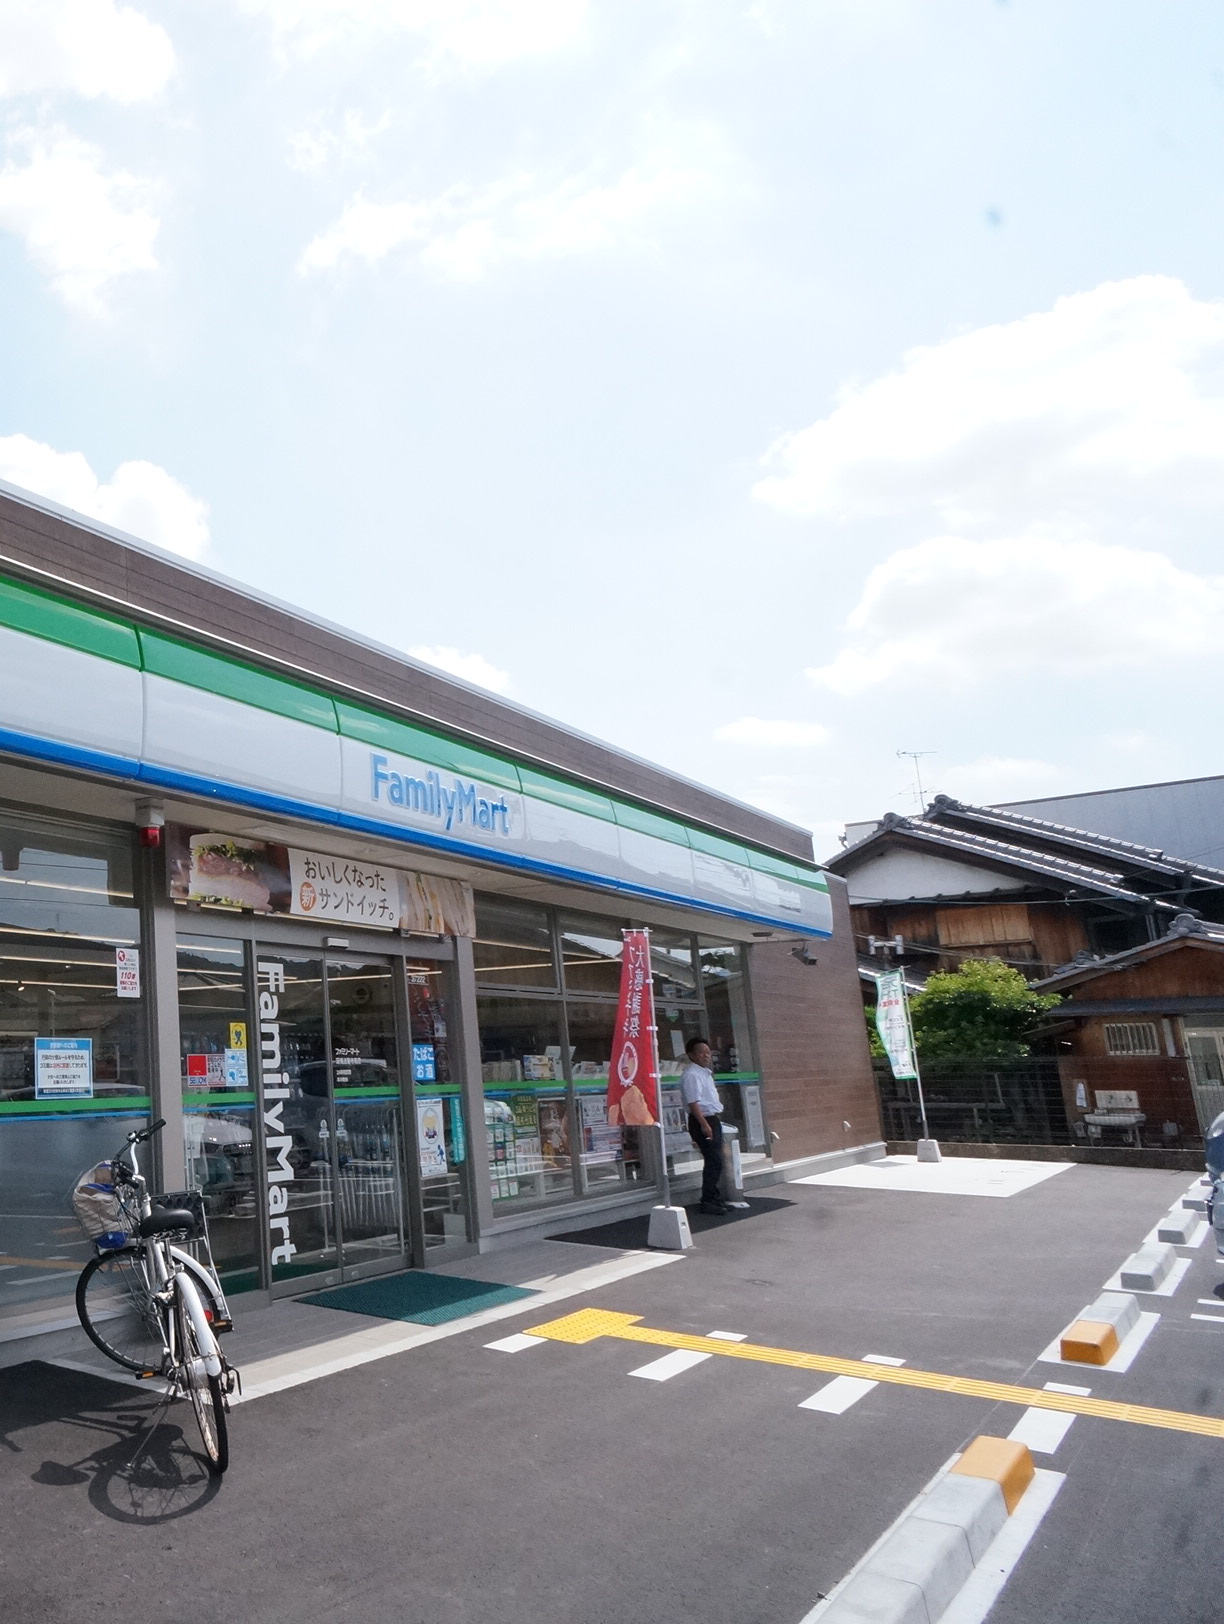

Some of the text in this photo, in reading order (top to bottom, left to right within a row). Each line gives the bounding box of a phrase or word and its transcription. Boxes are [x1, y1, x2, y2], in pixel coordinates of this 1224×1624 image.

[371, 752, 509, 835] FamilyMart
[304, 857, 387, 892] おいしくなった
[413, 1047, 435, 1061] たばこ
[416, 1063, 434, 1079] お酒
[257, 962, 297, 1266] FamilyMart
